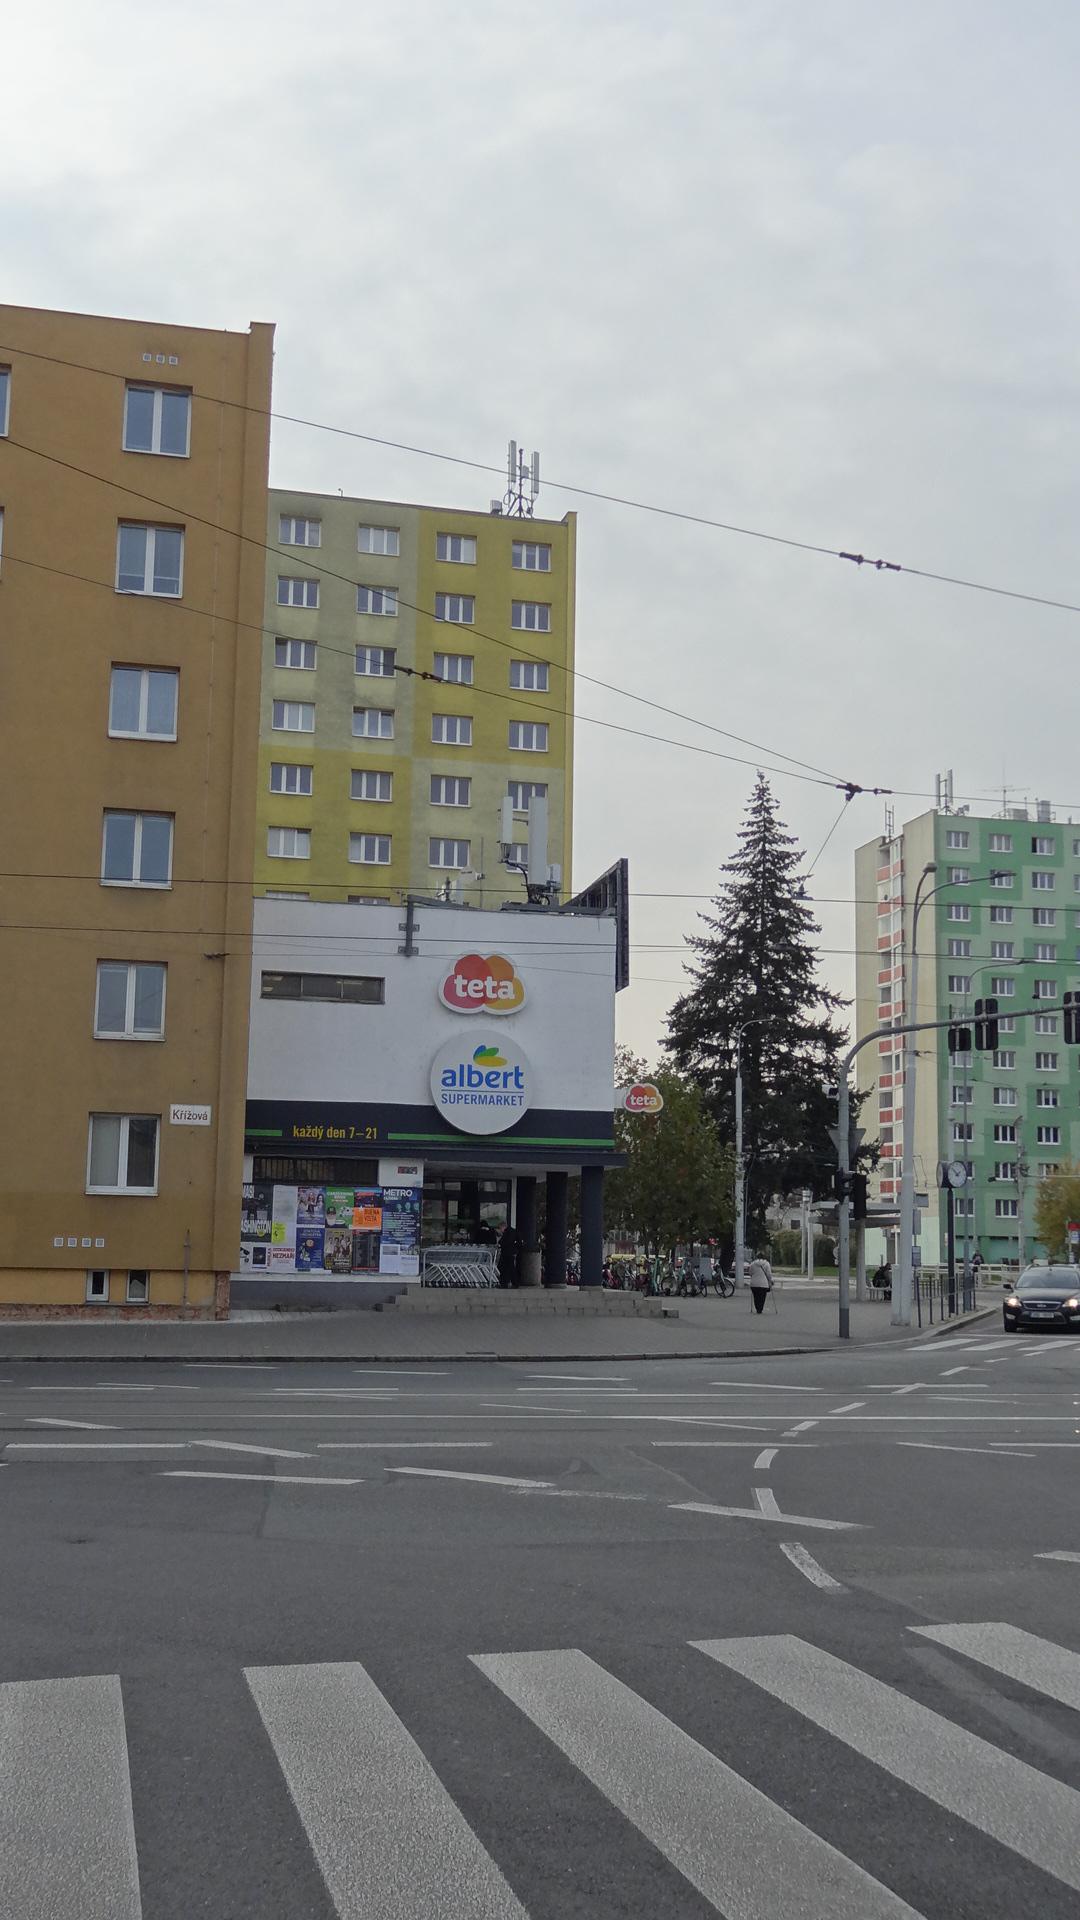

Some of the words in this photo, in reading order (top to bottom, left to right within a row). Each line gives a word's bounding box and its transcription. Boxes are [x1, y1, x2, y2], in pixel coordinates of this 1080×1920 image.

[454, 974, 515, 1000] teta
[441, 1064, 524, 1089] albert
[441, 1093, 524, 1106] SUPERMARKET
[630, 1095, 657, 1106] teta
[172, 1109, 208, 1120] Křížová
[293, 1125, 324, 1139] každý
[326, 1127, 345, 1138] den
[383, 1189, 412, 1197] METRO
